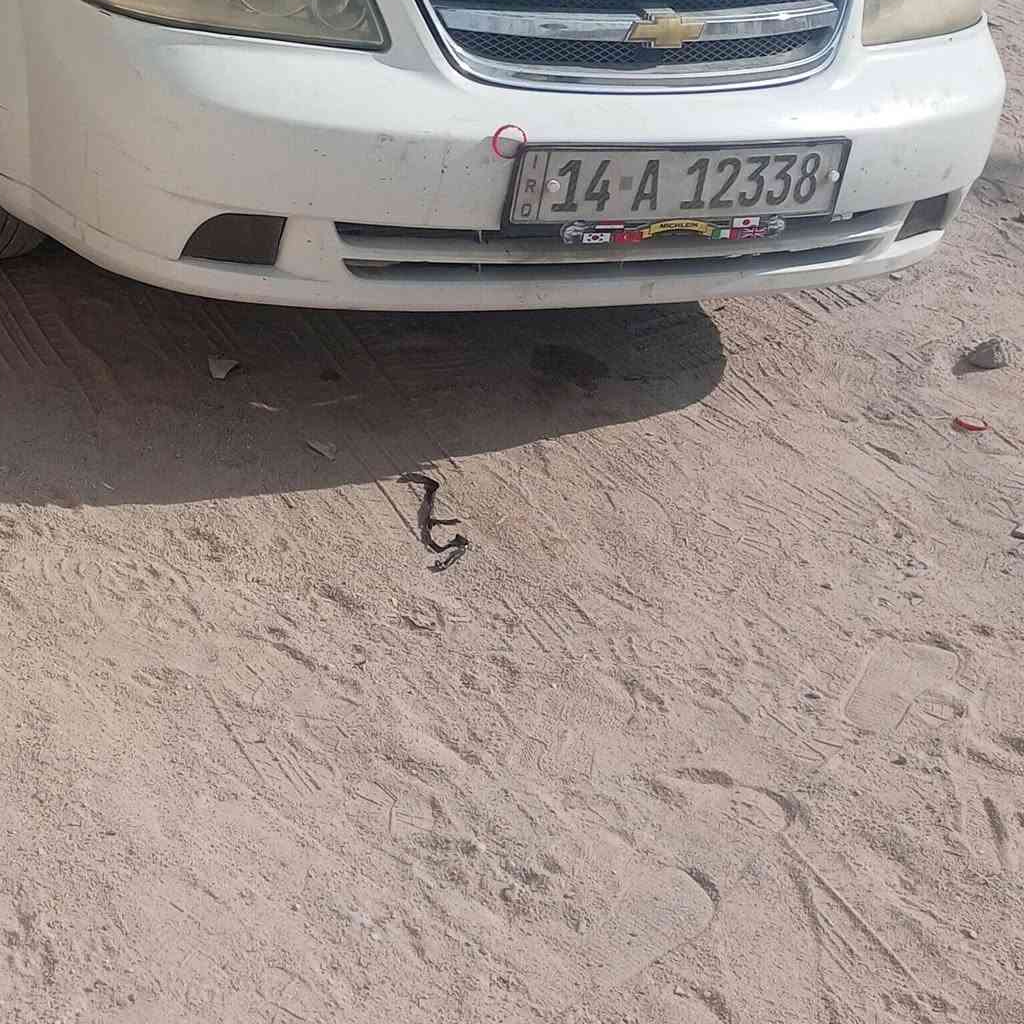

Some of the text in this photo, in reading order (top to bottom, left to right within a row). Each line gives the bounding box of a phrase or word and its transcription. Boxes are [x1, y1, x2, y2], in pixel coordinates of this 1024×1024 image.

[551, 153, 822, 212] 14 A 12338
